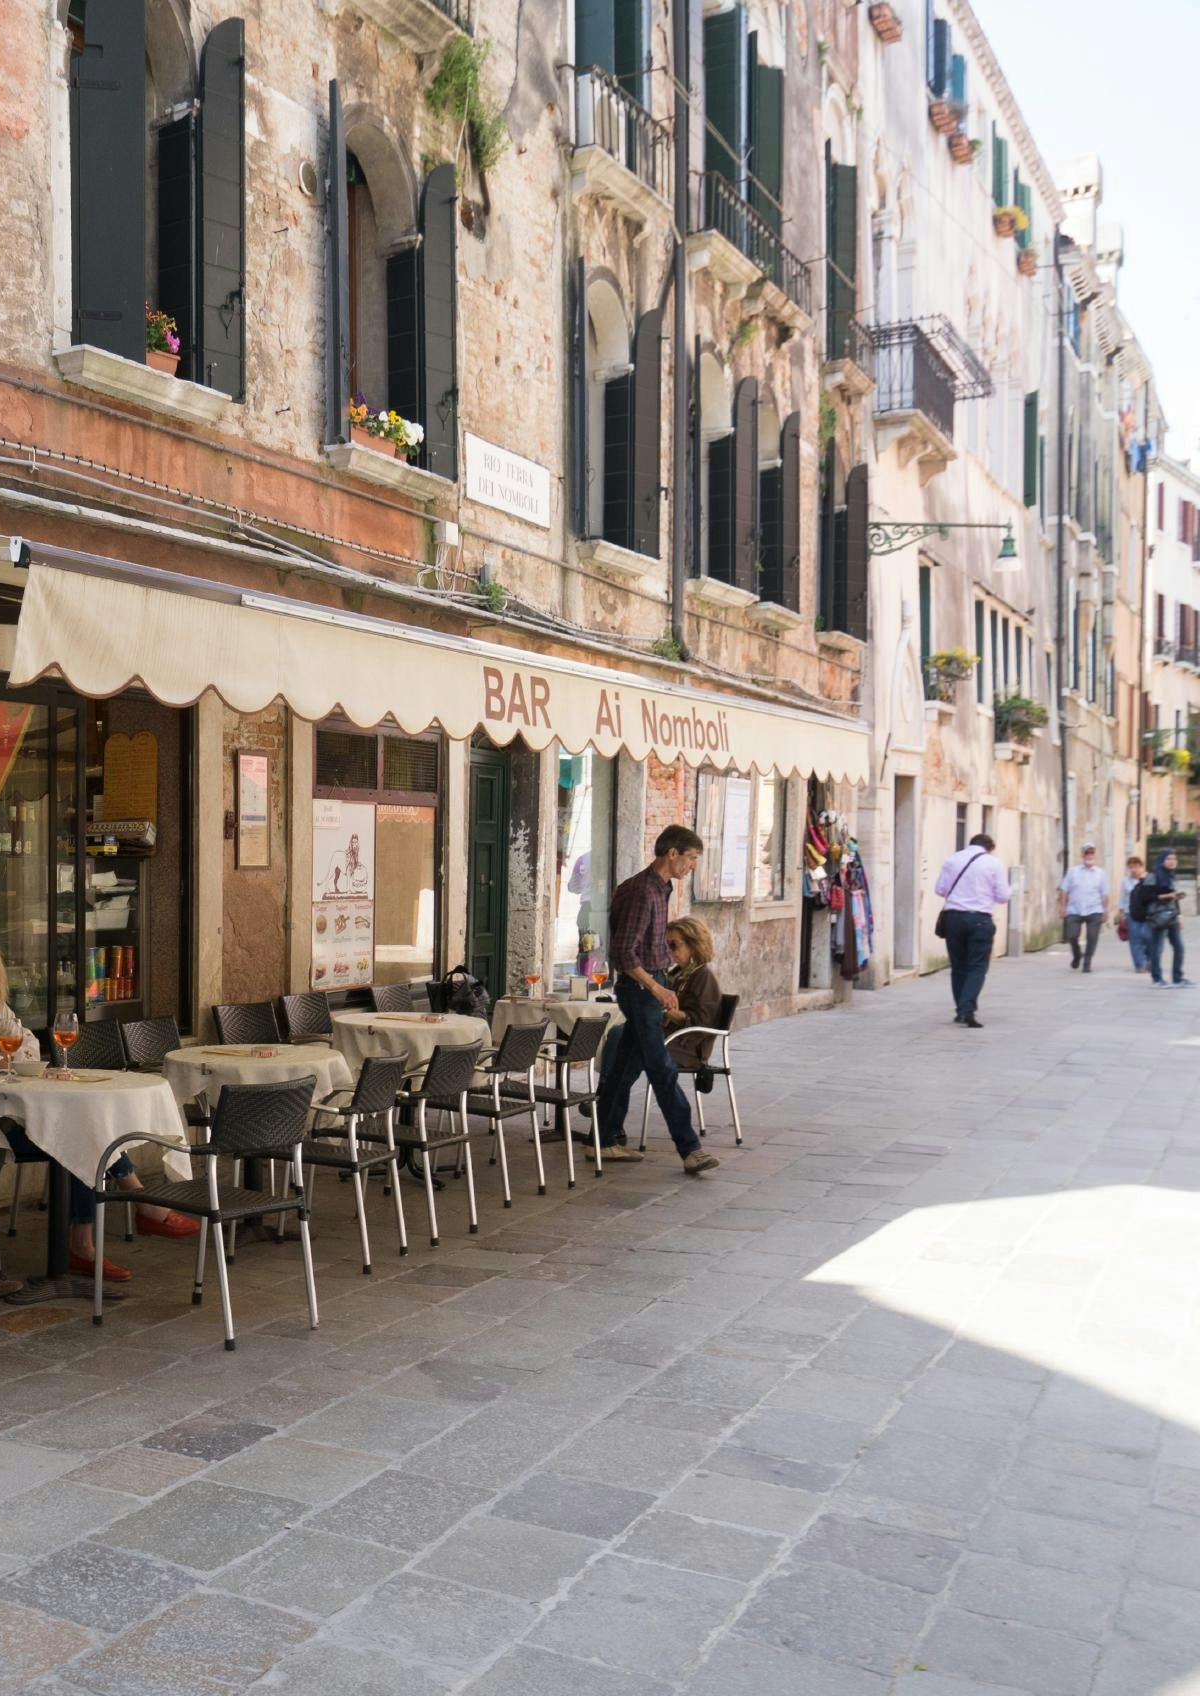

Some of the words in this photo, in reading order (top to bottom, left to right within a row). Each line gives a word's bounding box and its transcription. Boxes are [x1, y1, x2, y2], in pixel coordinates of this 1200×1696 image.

[484, 452, 502, 473] RIO
[478, 475, 494, 497] DEI
[498, 483, 539, 514] NOMBOLI
[483, 666, 552, 729] BAR
[595, 688, 622, 738] Ai
[641, 698, 730, 752] Nomboli
